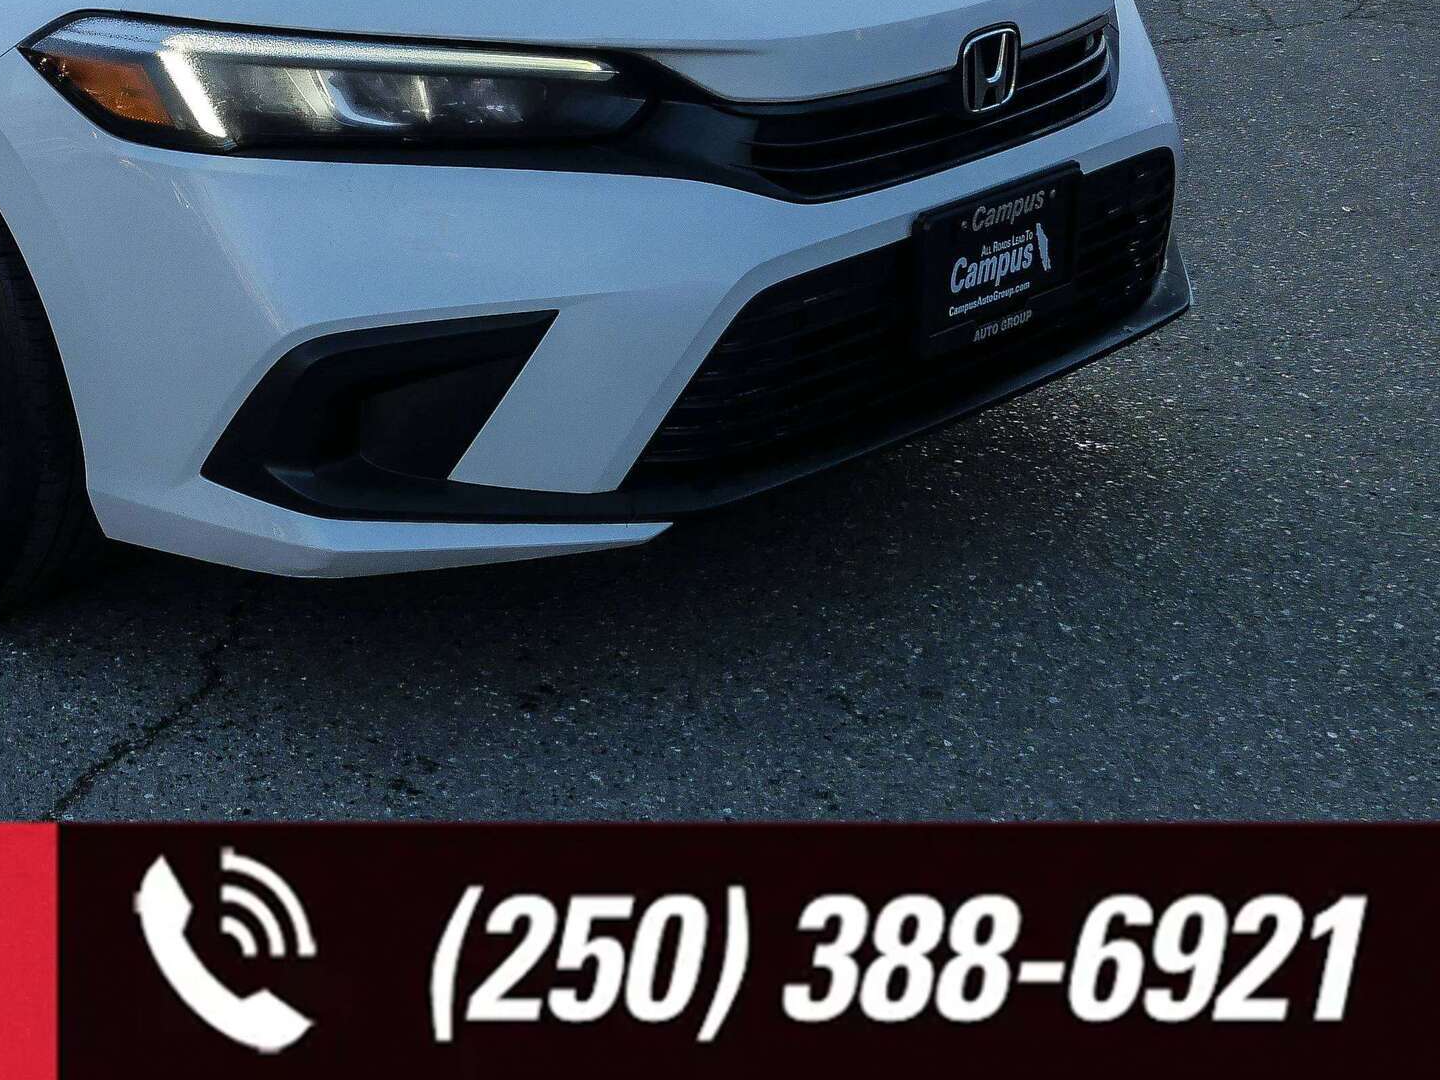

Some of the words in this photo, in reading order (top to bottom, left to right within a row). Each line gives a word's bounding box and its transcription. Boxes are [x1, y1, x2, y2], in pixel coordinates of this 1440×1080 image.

[972, 189, 1045, 231] Campus
[950, 242, 1034, 293] Campus
[949, 281, 1031, 317] CampusAutoGroup.com
[972, 322, 999, 342] AUTO
[1001, 309, 1033, 331] GROUP
